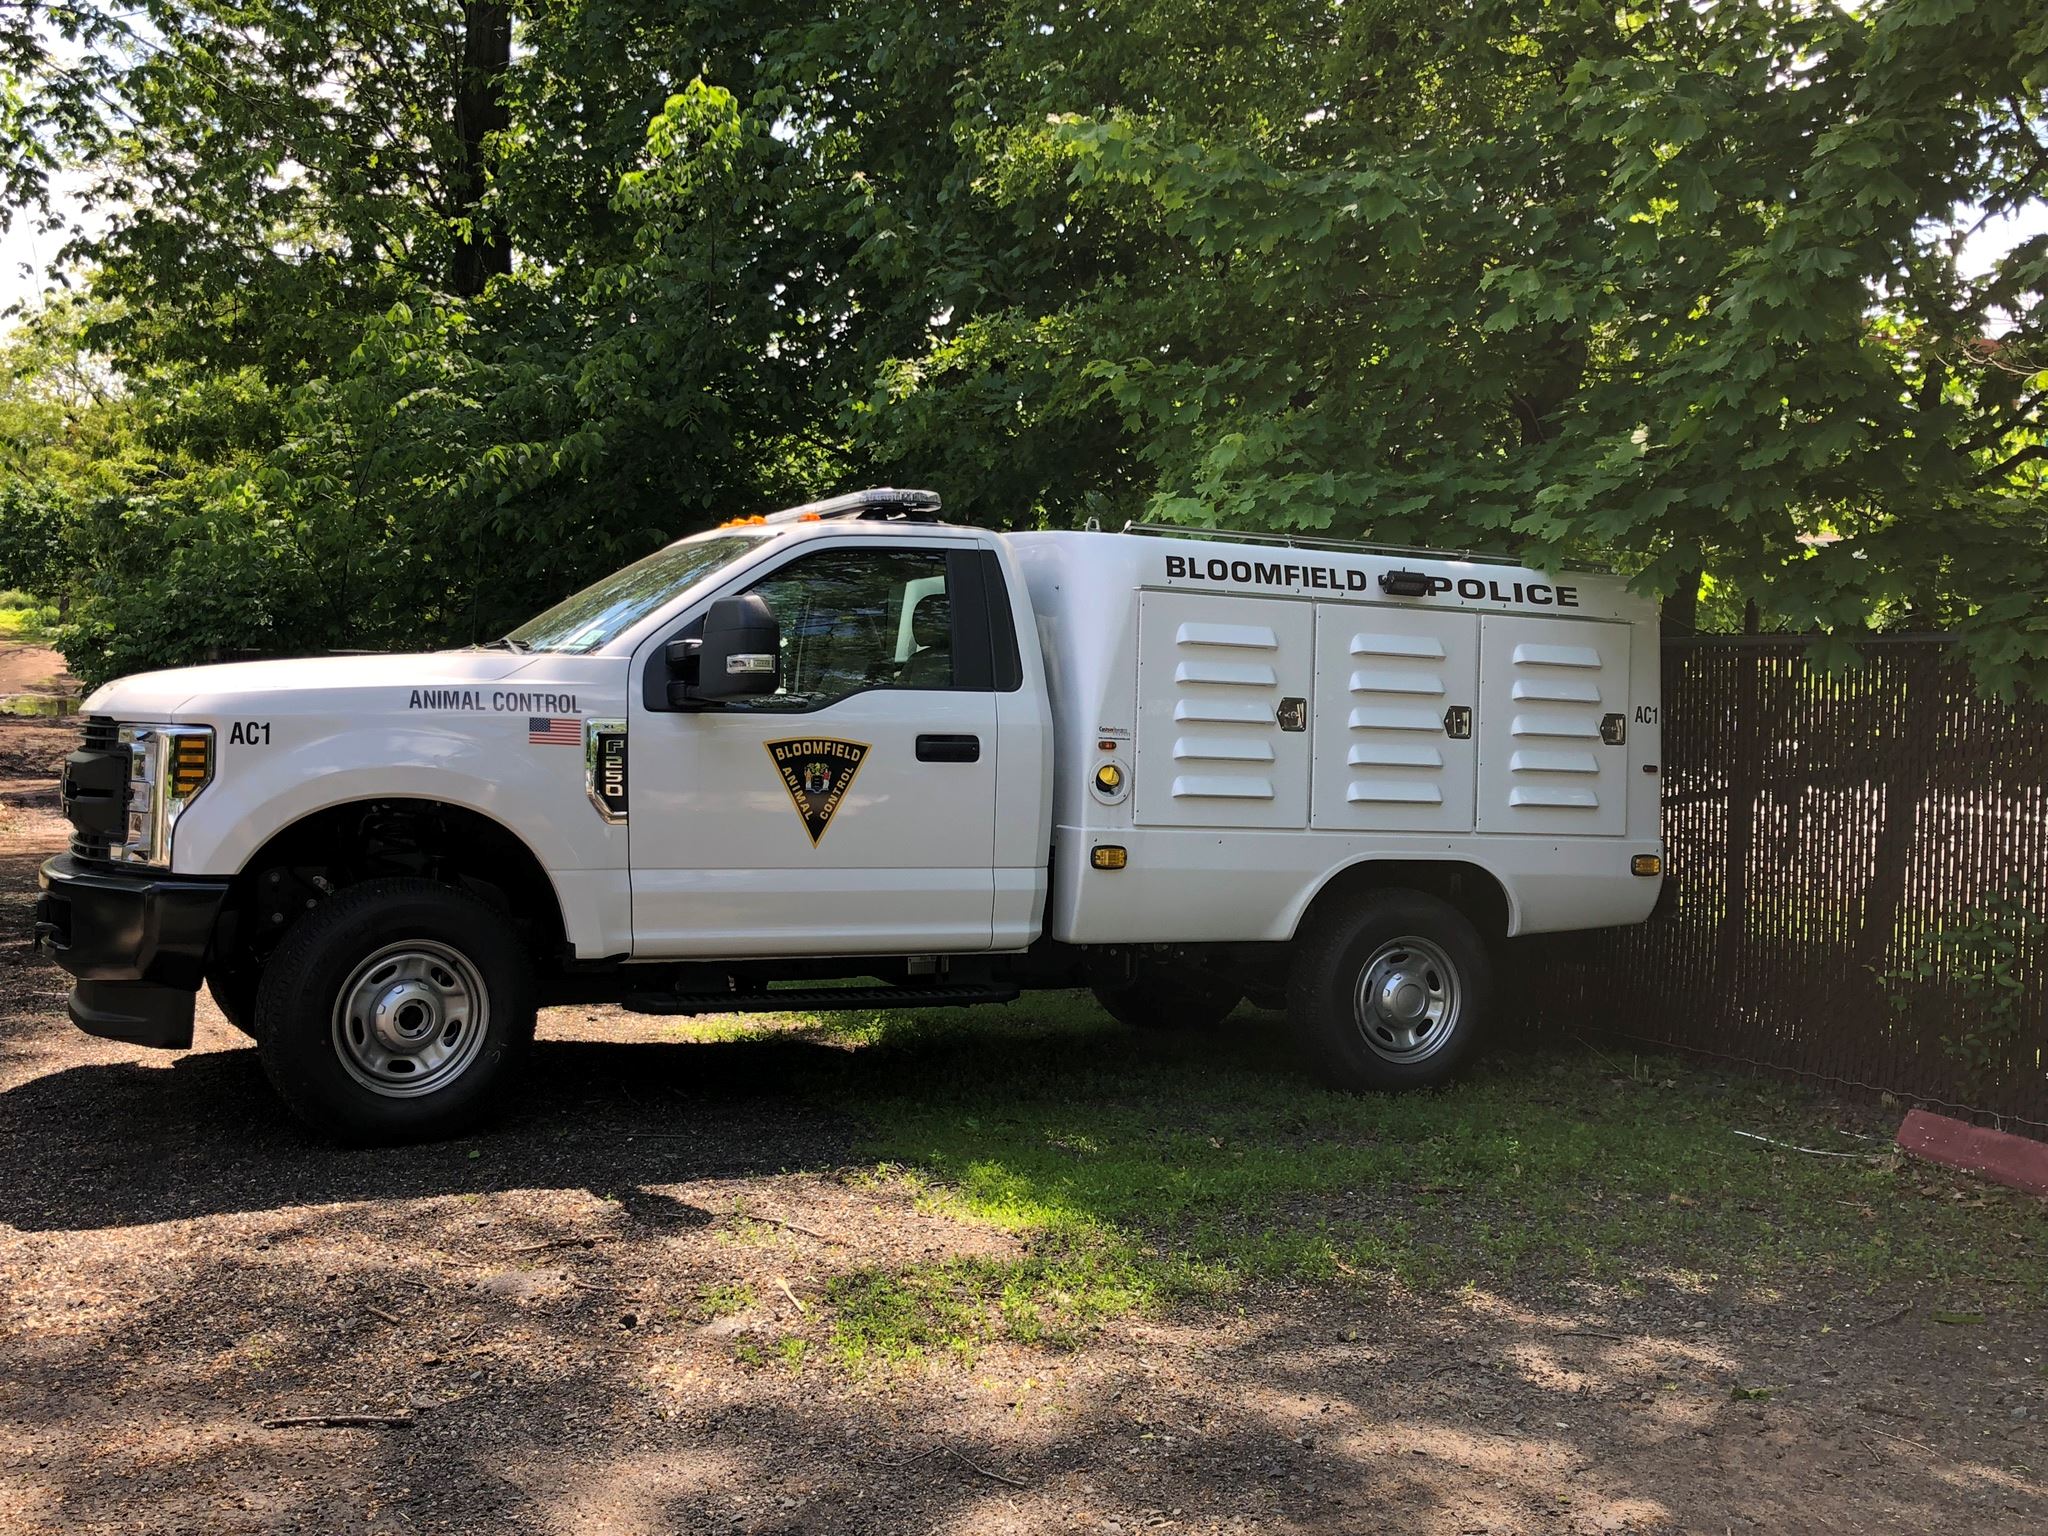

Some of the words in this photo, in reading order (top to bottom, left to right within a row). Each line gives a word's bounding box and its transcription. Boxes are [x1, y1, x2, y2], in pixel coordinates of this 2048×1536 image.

[1166, 555, 1367, 591] BLOOMFIELD
[1426, 576, 1579, 607] POLICE
[409, 690, 485, 711] ANIMAL
[493, 692, 582, 714] CONTROL
[1635, 705, 1658, 724] AC1
[229, 721, 270, 745] AC1
[776, 741, 861, 761] BLOOMFIELD
[606, 740, 624, 796] F250
[782, 766, 814, 820] ANIMAL
[819, 767, 854, 820] CONTROL
